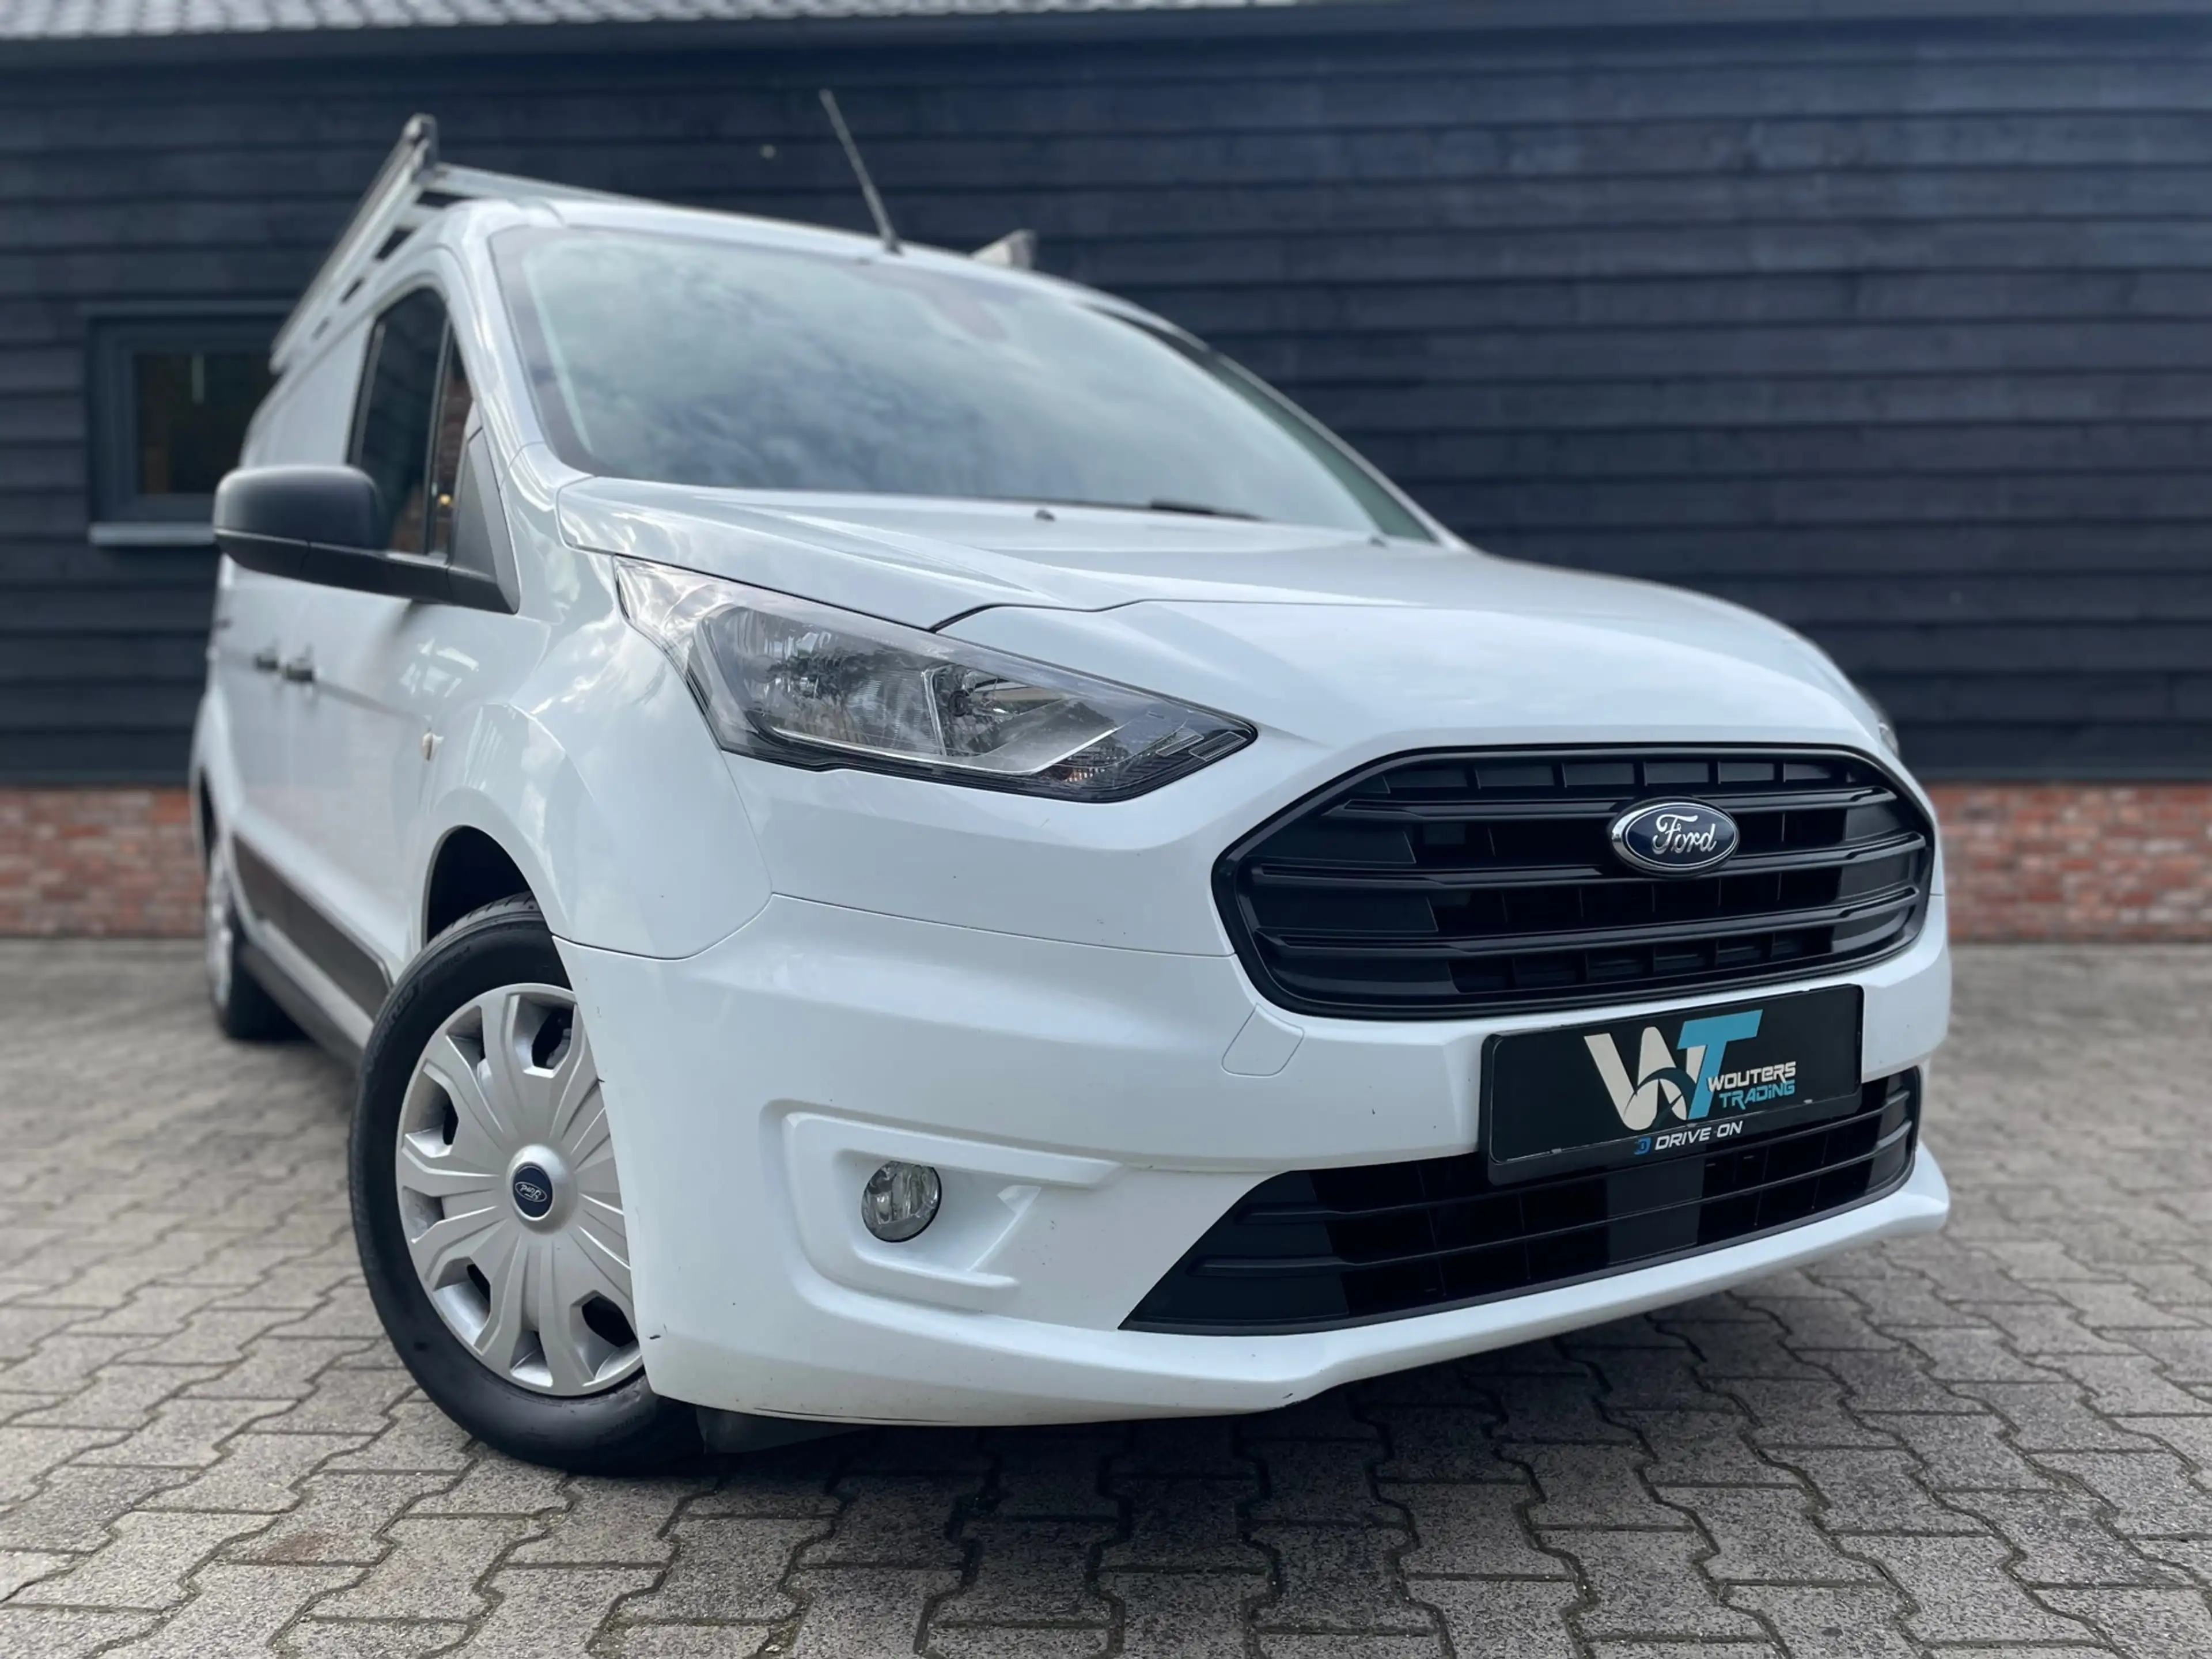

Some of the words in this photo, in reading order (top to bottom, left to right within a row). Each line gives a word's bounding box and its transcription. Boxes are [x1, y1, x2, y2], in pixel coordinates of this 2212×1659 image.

[1652, 813, 1717, 855] Ford
[1654, 1127, 1712, 1151] DRIVE
[1717, 1120, 1743, 1138] ON
